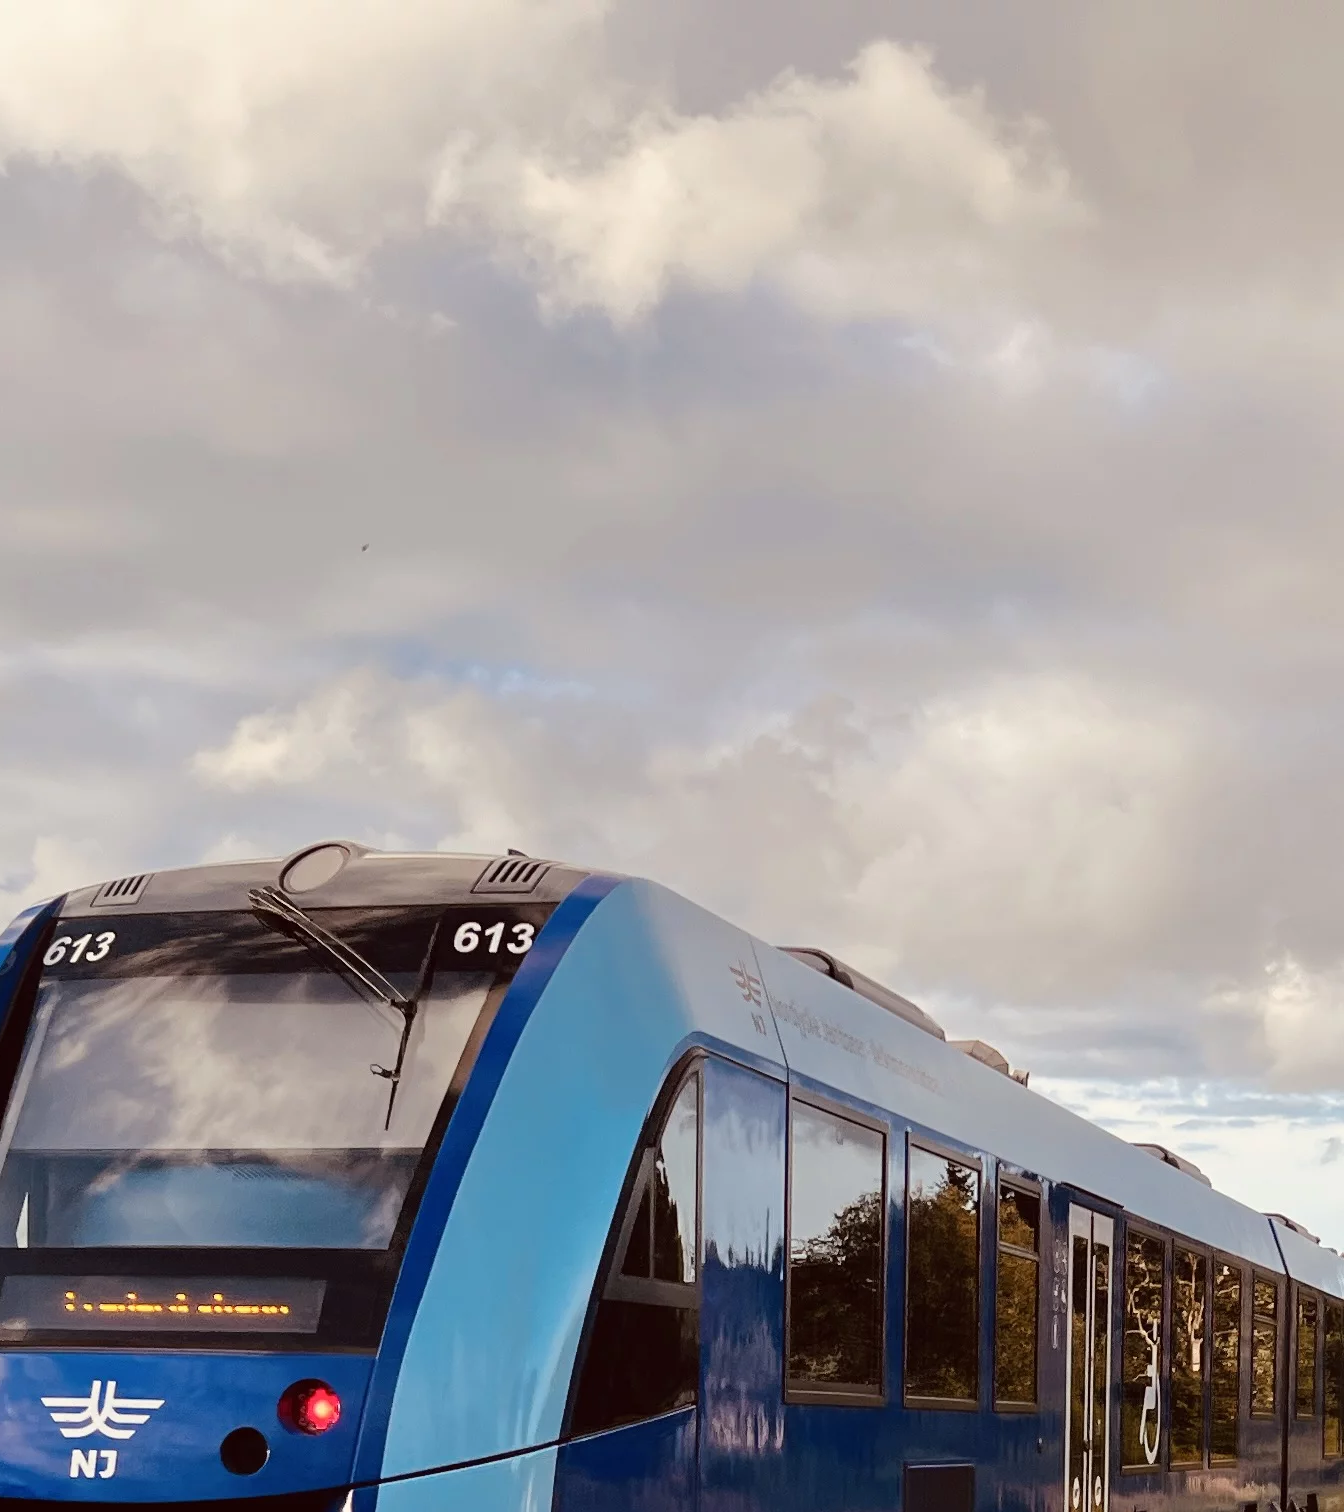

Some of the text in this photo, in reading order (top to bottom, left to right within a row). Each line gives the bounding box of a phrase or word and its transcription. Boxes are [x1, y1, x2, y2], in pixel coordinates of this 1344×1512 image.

[43, 931, 116, 966] 613
[453, 921, 535, 955] 613
[69, 1448, 118, 1479] NJ
